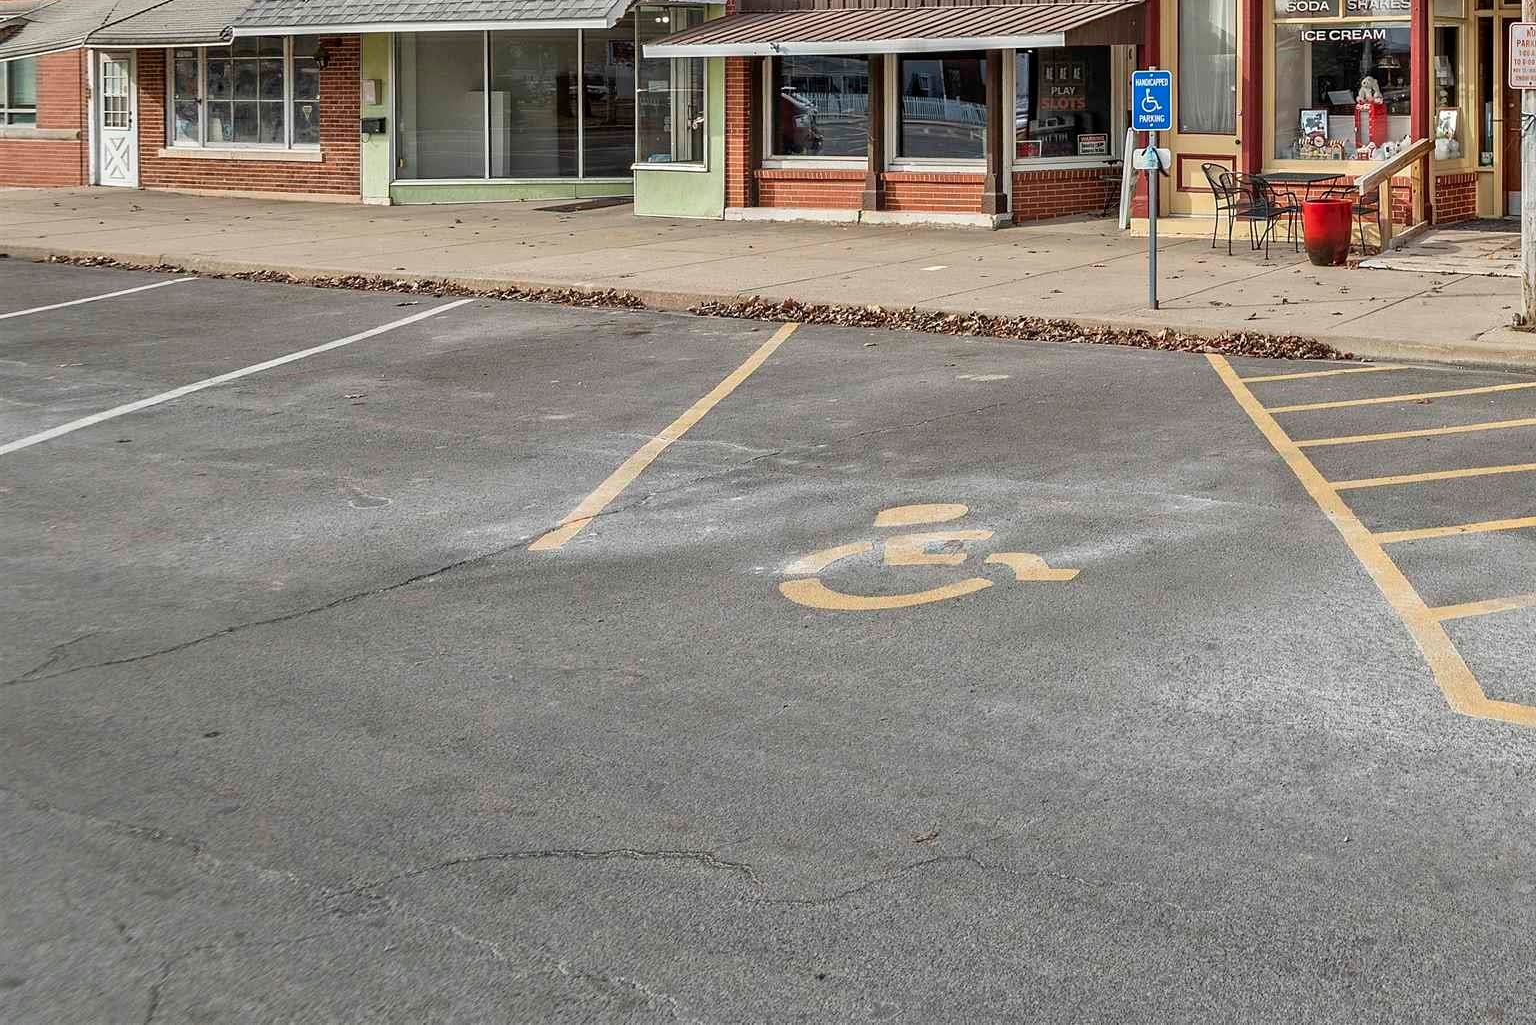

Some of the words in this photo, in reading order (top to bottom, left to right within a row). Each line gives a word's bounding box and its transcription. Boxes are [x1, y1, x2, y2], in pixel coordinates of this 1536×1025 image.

[1286, 1, 1330, 12] SODA
[1301, 30, 1326, 41] ICE
[1329, 29, 1386, 41] CREAM
[1135, 78, 1169, 87] HANDICAPPED
[1051, 86, 1076, 95] PLAY
[1041, 97, 1087, 111] SLOTS
[1139, 115, 1165, 123] PARKING
